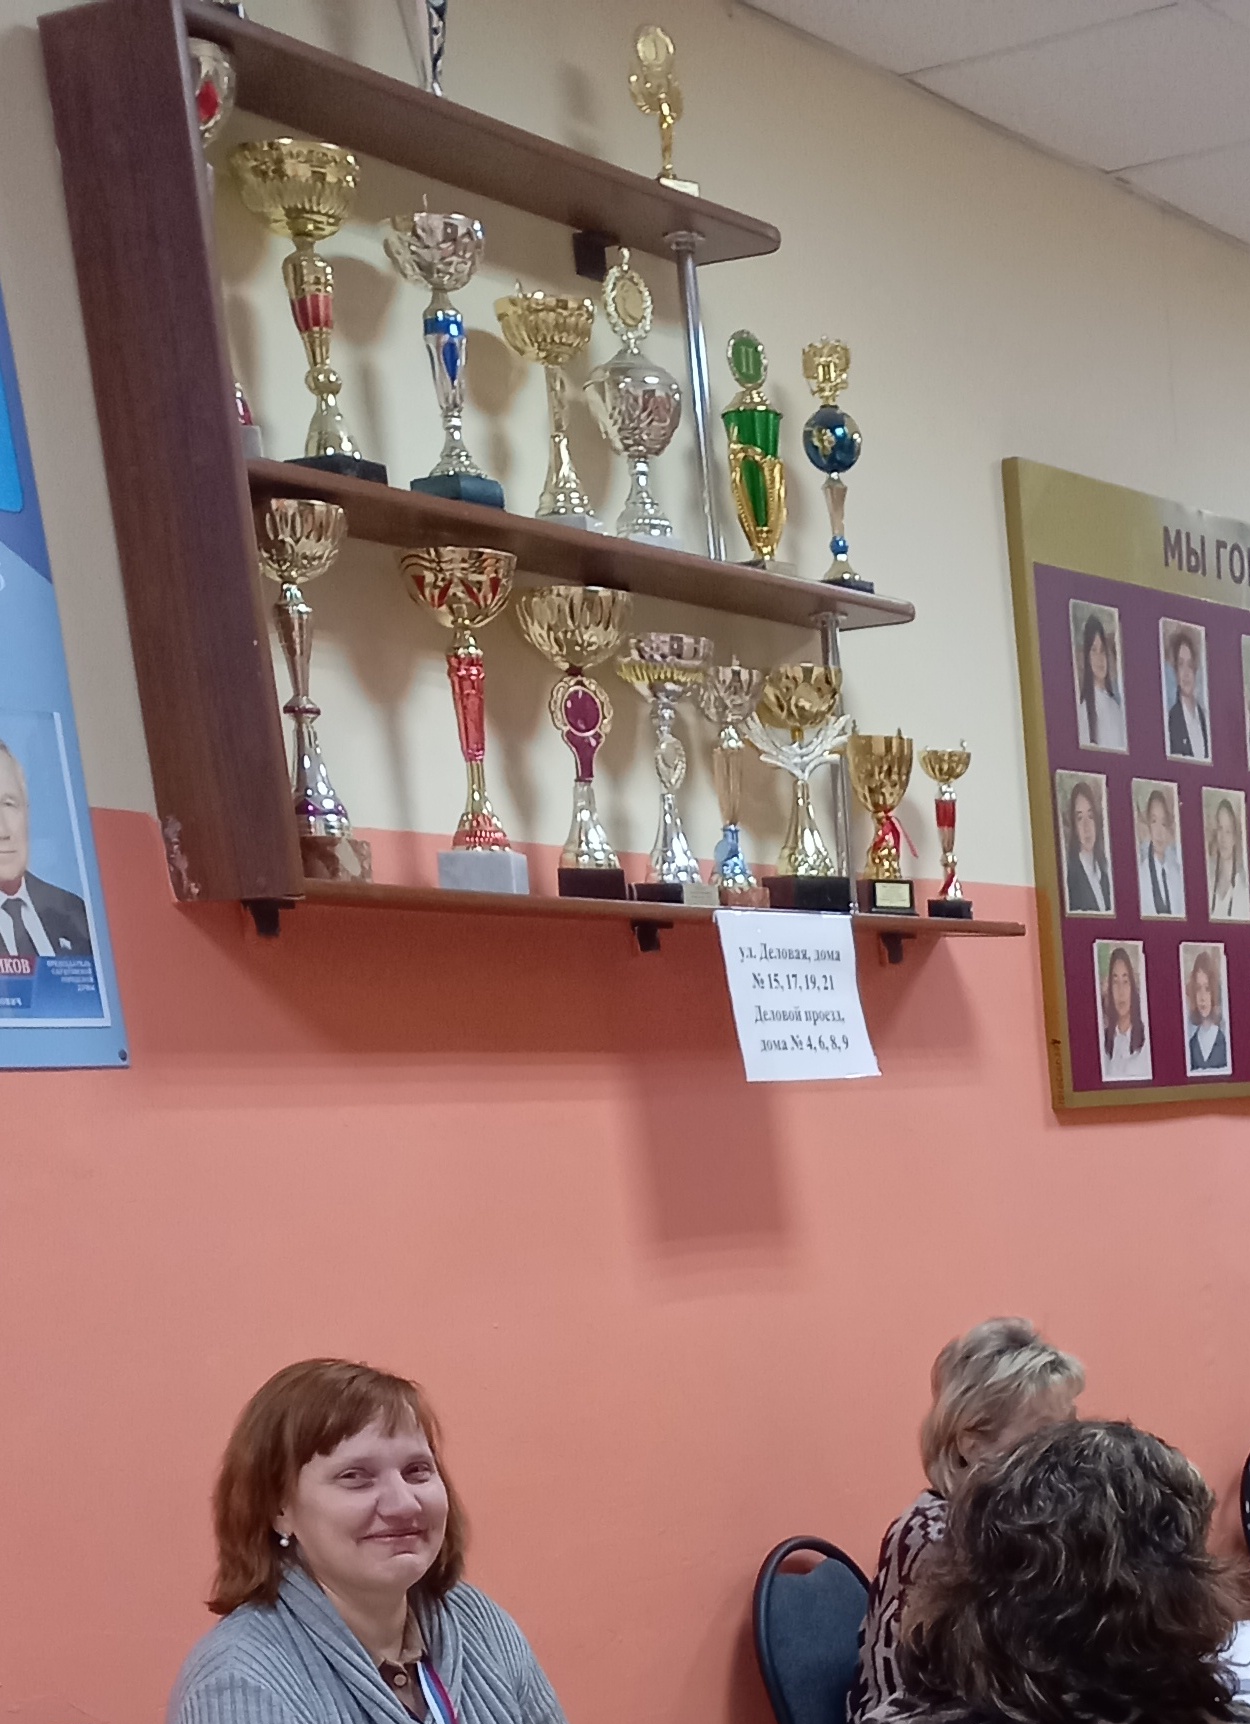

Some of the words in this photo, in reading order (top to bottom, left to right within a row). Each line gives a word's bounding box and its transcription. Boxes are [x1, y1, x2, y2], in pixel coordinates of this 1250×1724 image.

[1162, 525, 1207, 577] МЫ
[738, 946, 757, 963] ул.
[759, 943, 812, 963] Деловая,
[813, 948, 841, 962] дома
[767, 973, 785, 991] 15,
[786, 973, 803, 992] 17,
[804, 974, 821, 992] 19,
[822, 974, 835, 991] 21
[754, 1005, 802, 1024] Деловой
[760, 1039, 788, 1053] дома
[818, 1034, 829, 1053] 6,
[829, 1034, 842, 1052] 8,
[842, 1034, 849, 1050] 9
